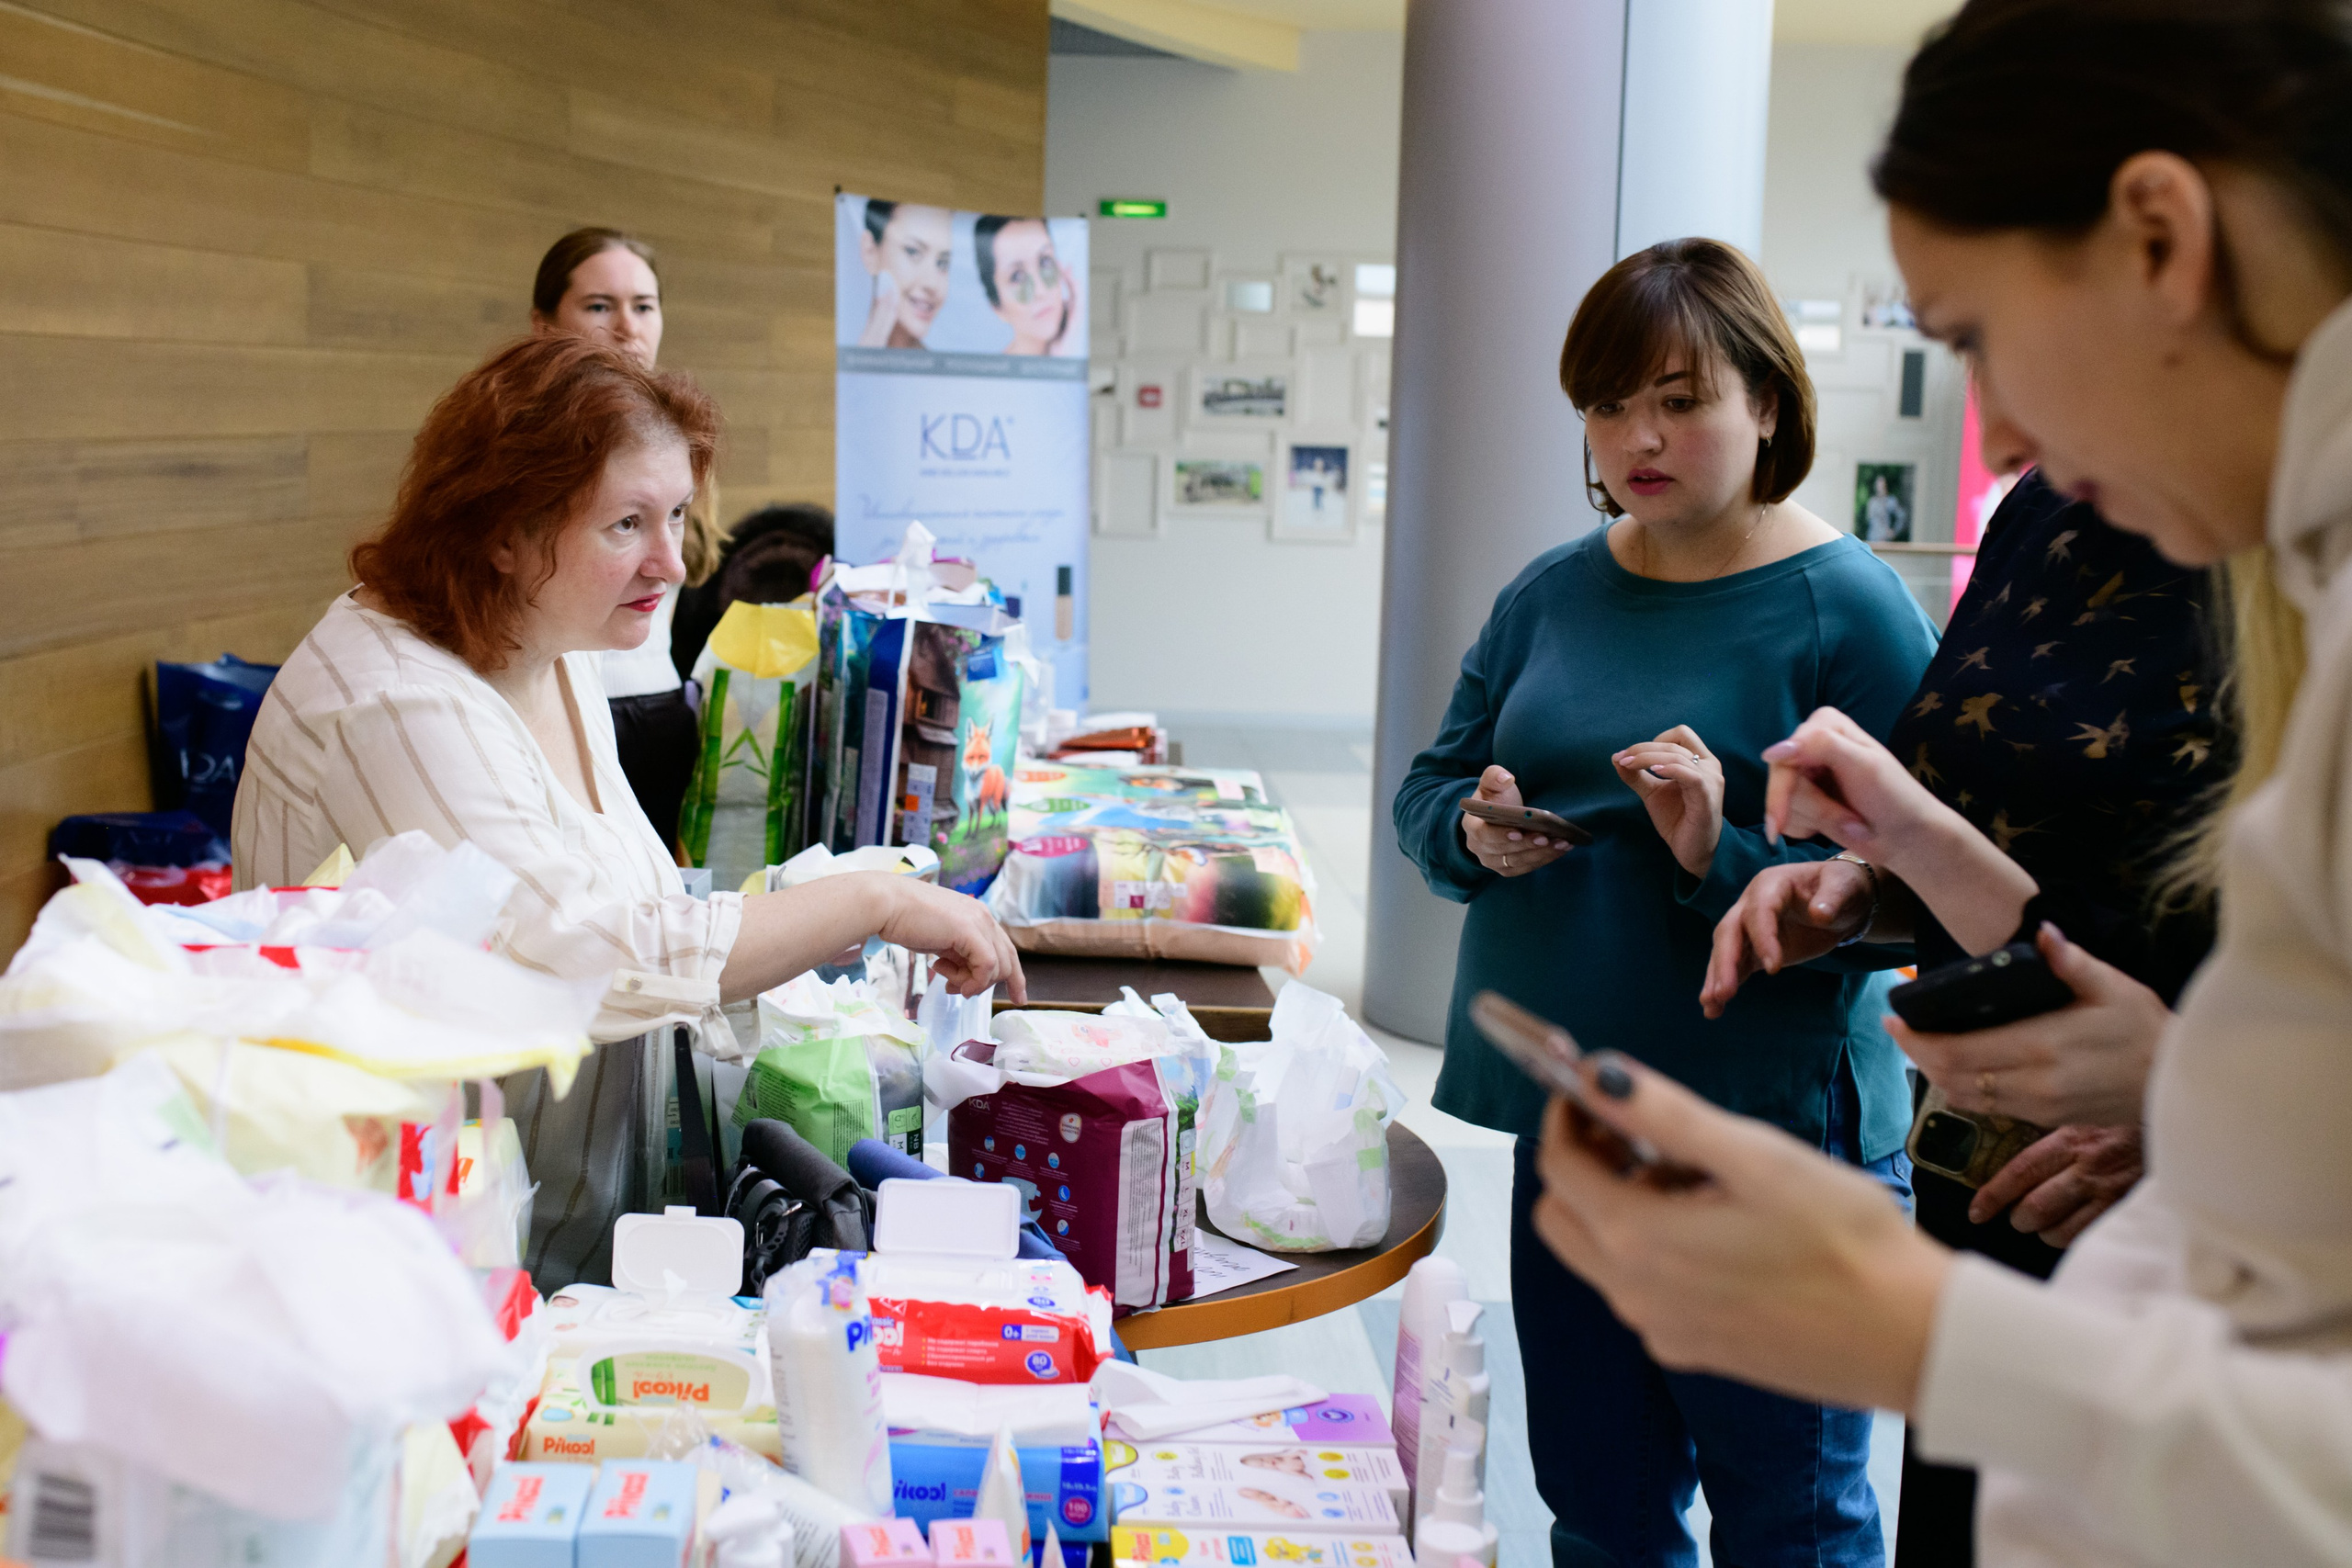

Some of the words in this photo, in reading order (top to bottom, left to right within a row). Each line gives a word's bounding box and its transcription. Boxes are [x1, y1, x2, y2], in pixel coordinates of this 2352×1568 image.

[919, 413, 1012, 461] KDA
[967, 1098, 991, 1112] KDA
[1004, 1325, 1020, 1339] 0+
[1032, 1354, 1047, 1366] 80
[633, 1380, 709, 1403] Pikool
[543, 1436, 595, 1455] Pikool
[894, 1479, 946, 1501] ikool
